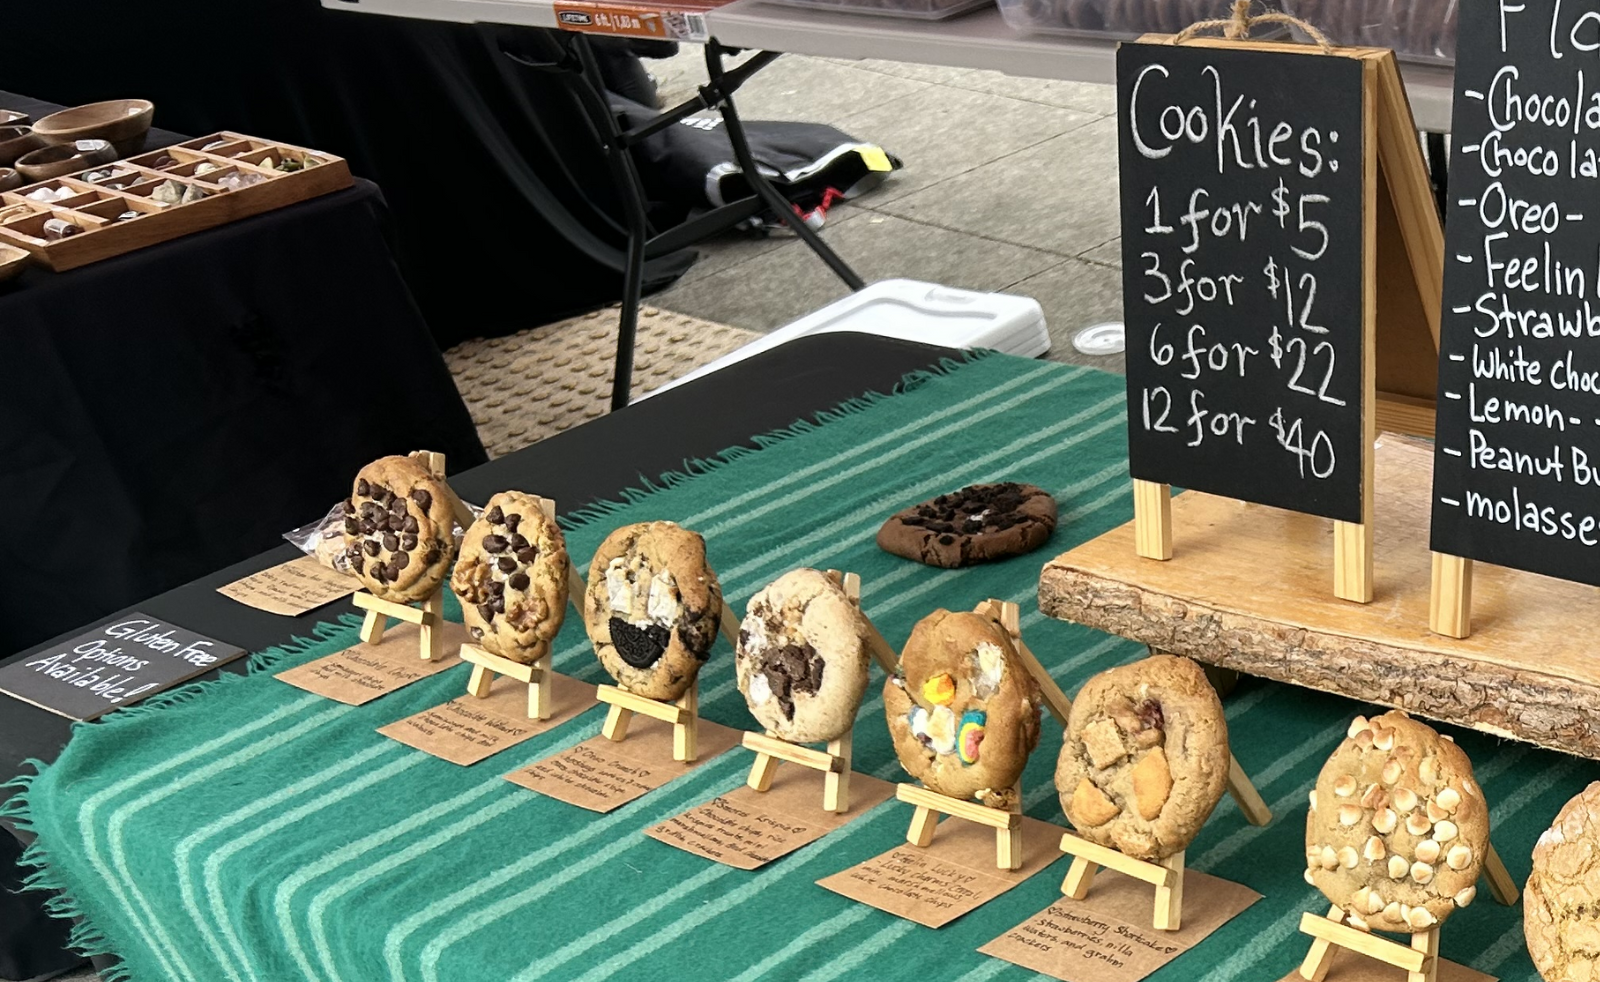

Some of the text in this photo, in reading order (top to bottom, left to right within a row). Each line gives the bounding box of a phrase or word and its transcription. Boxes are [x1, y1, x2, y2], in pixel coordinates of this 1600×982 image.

[1130, 64, 1340, 178] Cookies:
[1145, 177, 1330, 261] 1 for $5
[1141, 252, 1329, 334] 3 for $12
[1150, 323, 1346, 406] 6 for $22
[1143, 387, 1336, 479] 12 for $40
[26, 653, 159, 704] Available!
[73, 639, 149, 671] Options
[105, 619, 218, 667] Gluten Free
[1114, 925, 1163, 952] Shortcake
